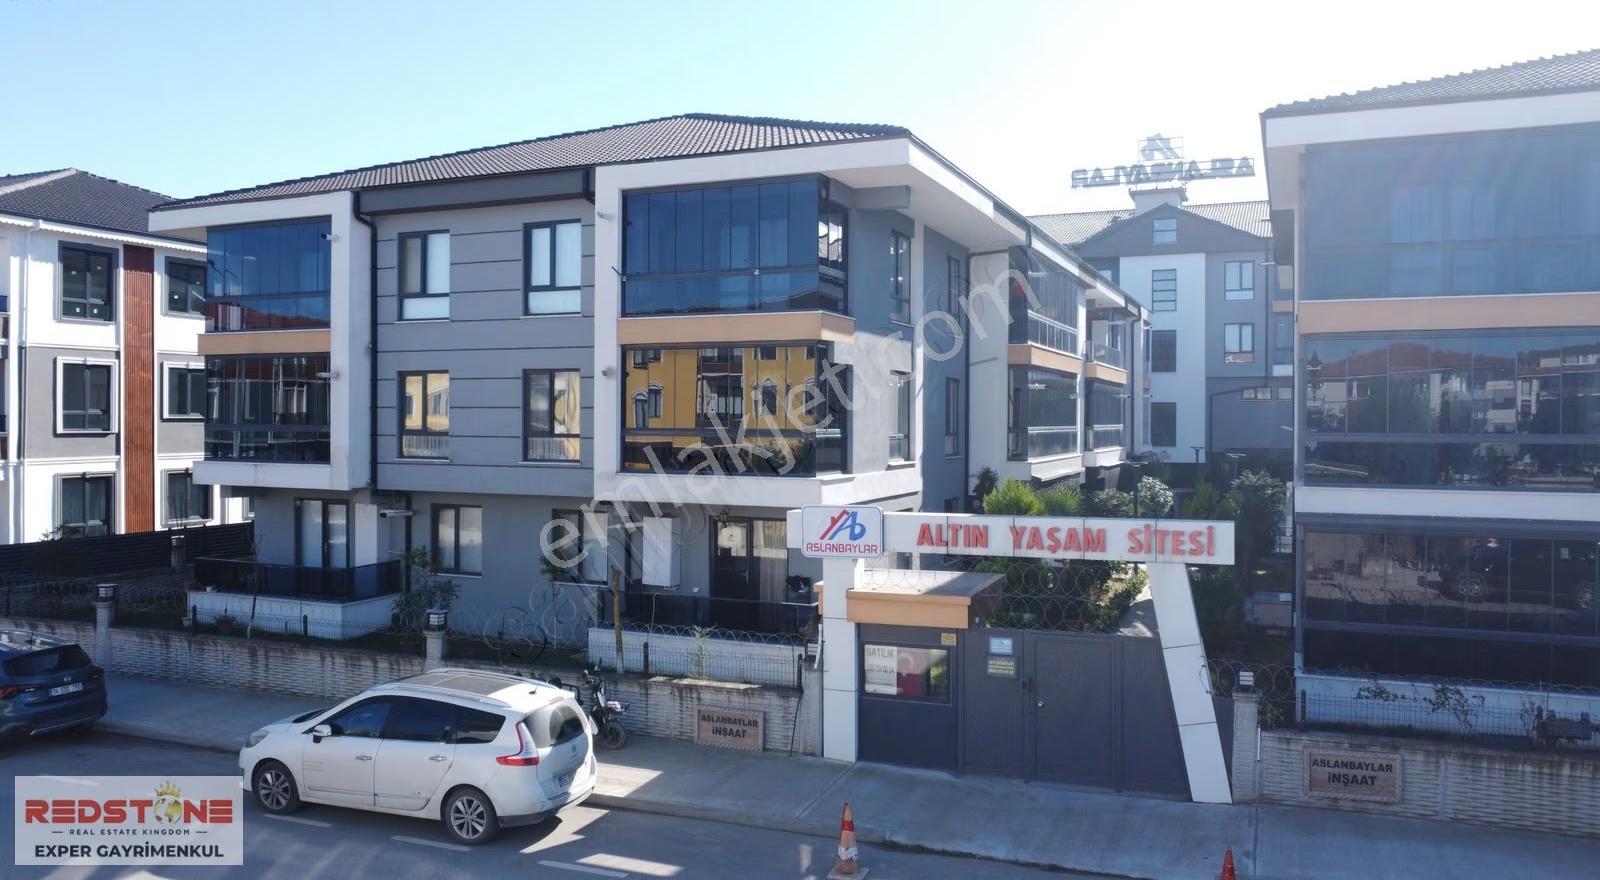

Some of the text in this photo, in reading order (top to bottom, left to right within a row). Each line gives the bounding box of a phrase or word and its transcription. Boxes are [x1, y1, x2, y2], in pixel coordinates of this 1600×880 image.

[916, 523, 1216, 556] ALTIN YAŞAM SİTESİ
[806, 543, 878, 553] ASLANBAYLAR
[701, 714, 759, 728] ASLANBAYLAR
[1312, 759, 1393, 773] ASLANBAYLAR
[1328, 772, 1377, 787] İNŞAAT
